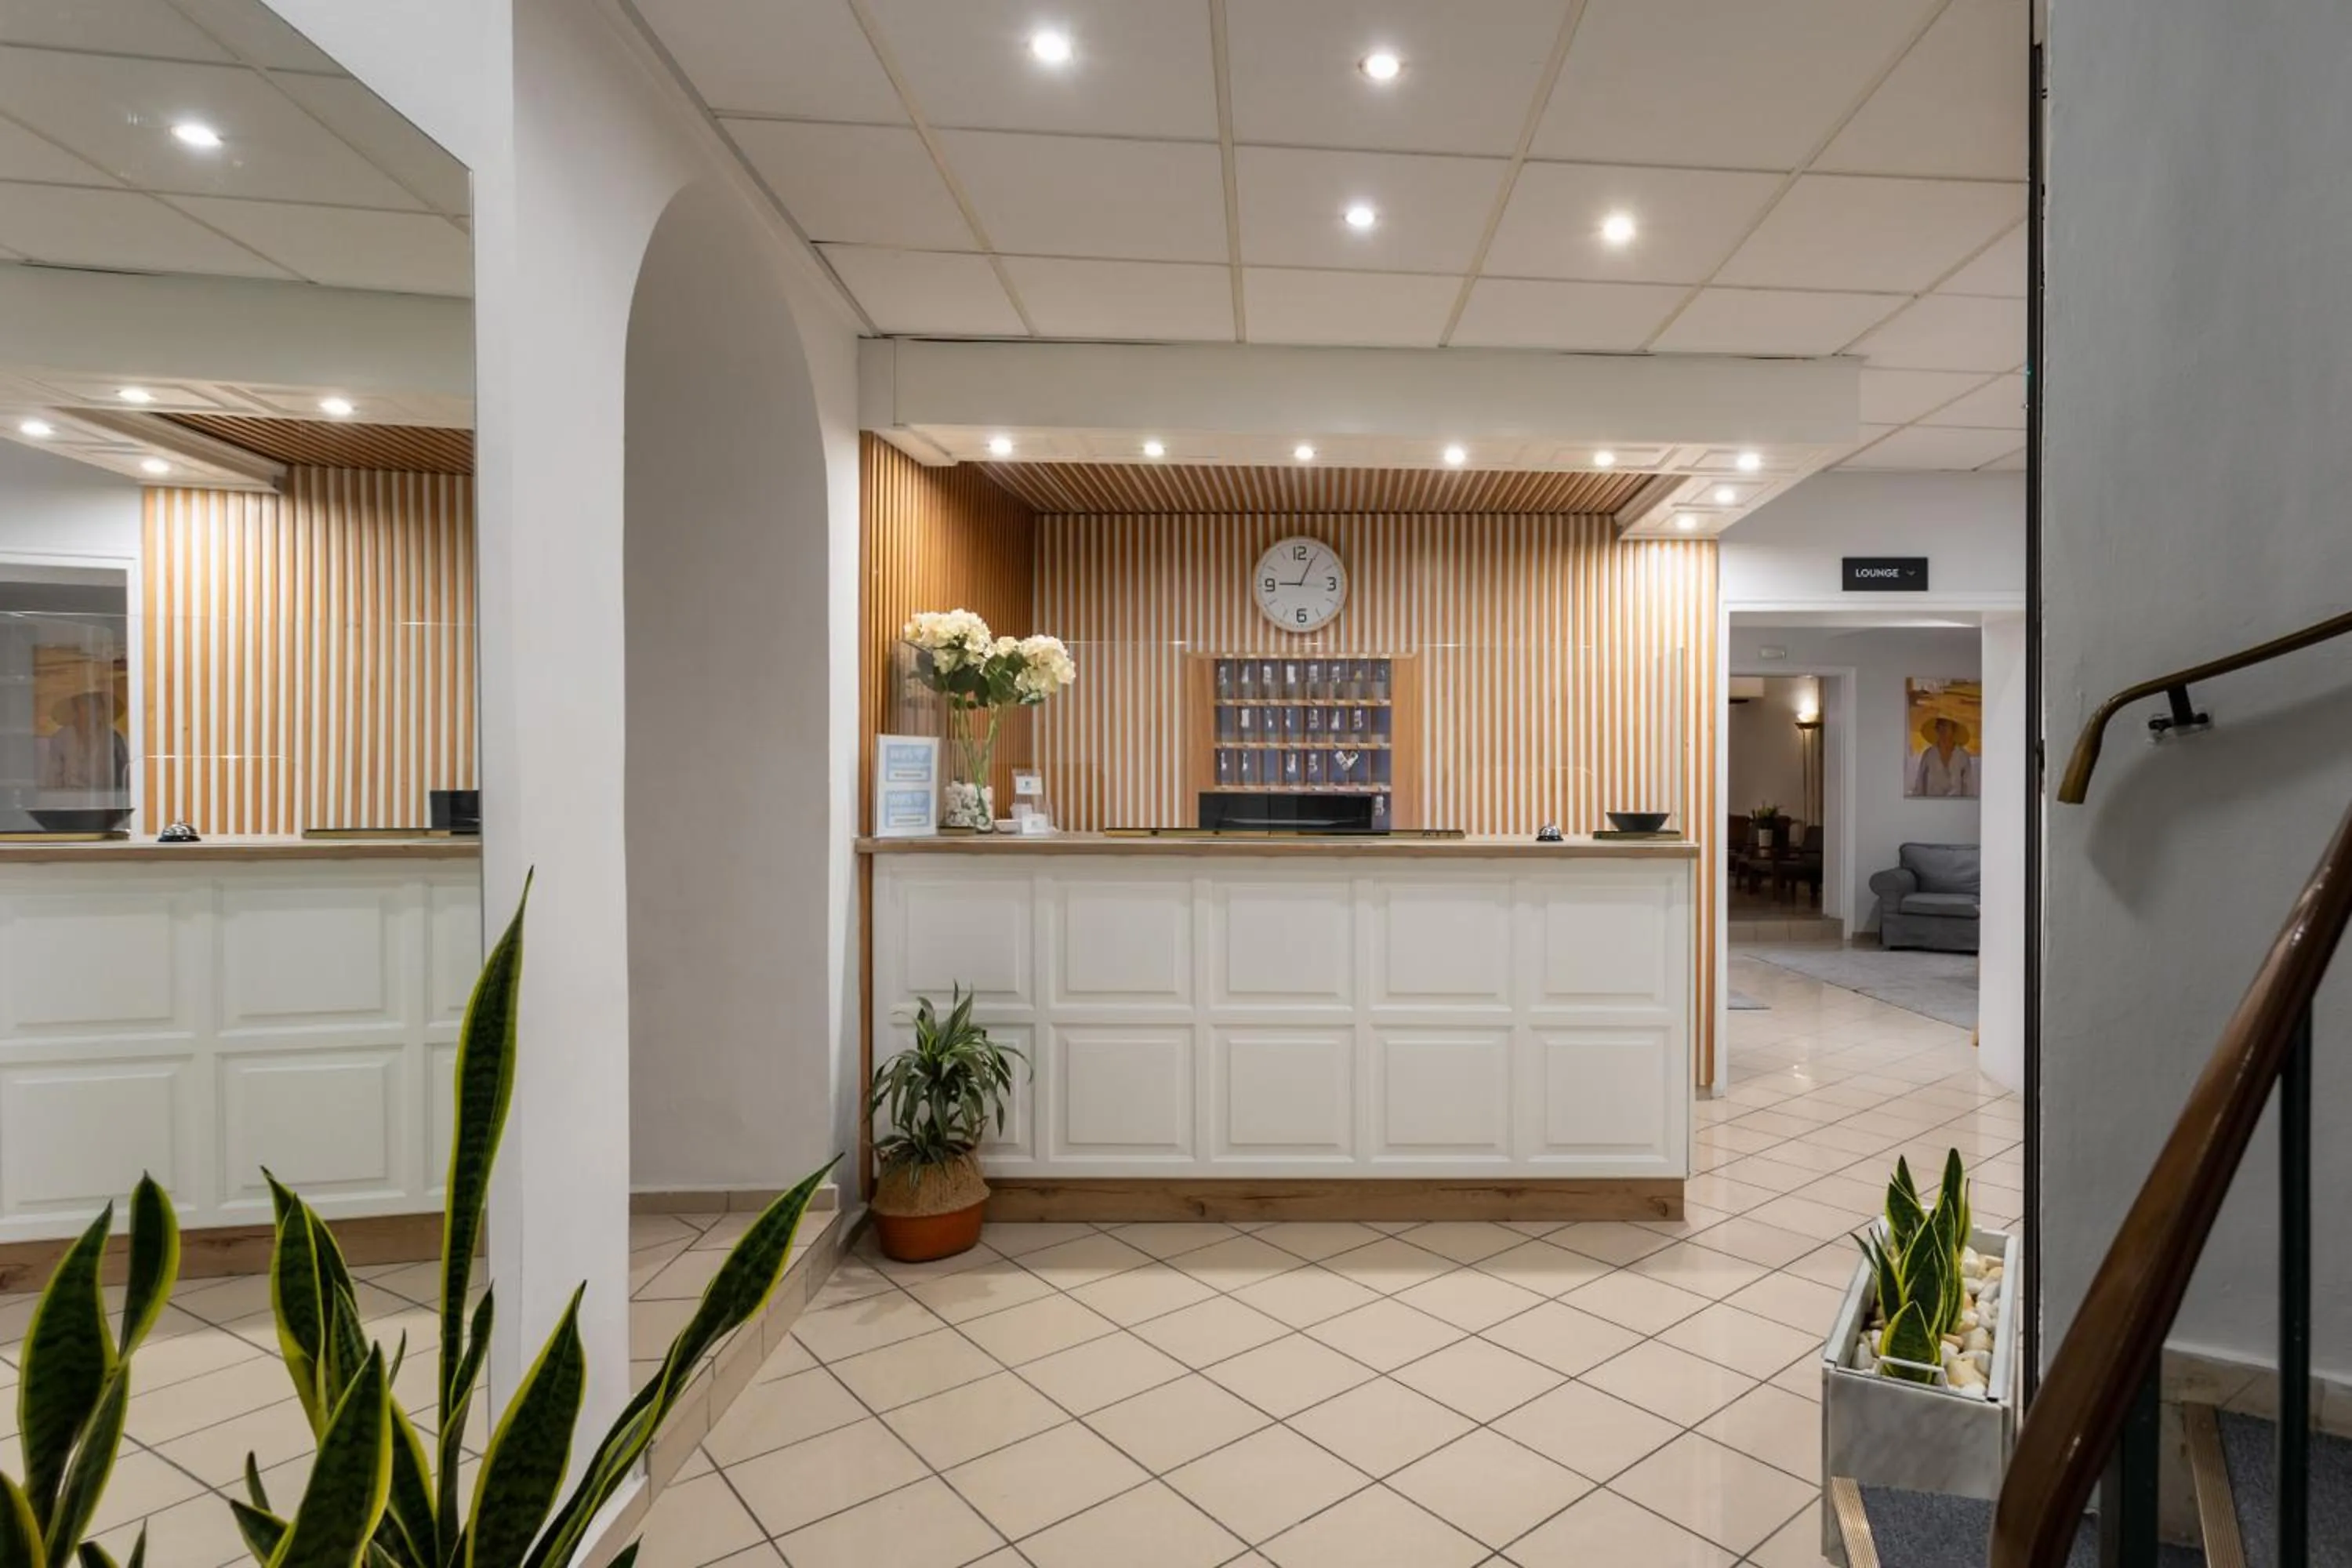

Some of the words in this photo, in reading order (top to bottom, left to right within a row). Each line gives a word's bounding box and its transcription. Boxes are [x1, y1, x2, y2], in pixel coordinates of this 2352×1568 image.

[1293, 546, 1308, 561] 12
[1855, 568, 1900, 578] LOUNGE
[1265, 578, 1276, 593] 9
[1327, 576, 1337, 592] 3
[1296, 608, 1307, 623] 6
